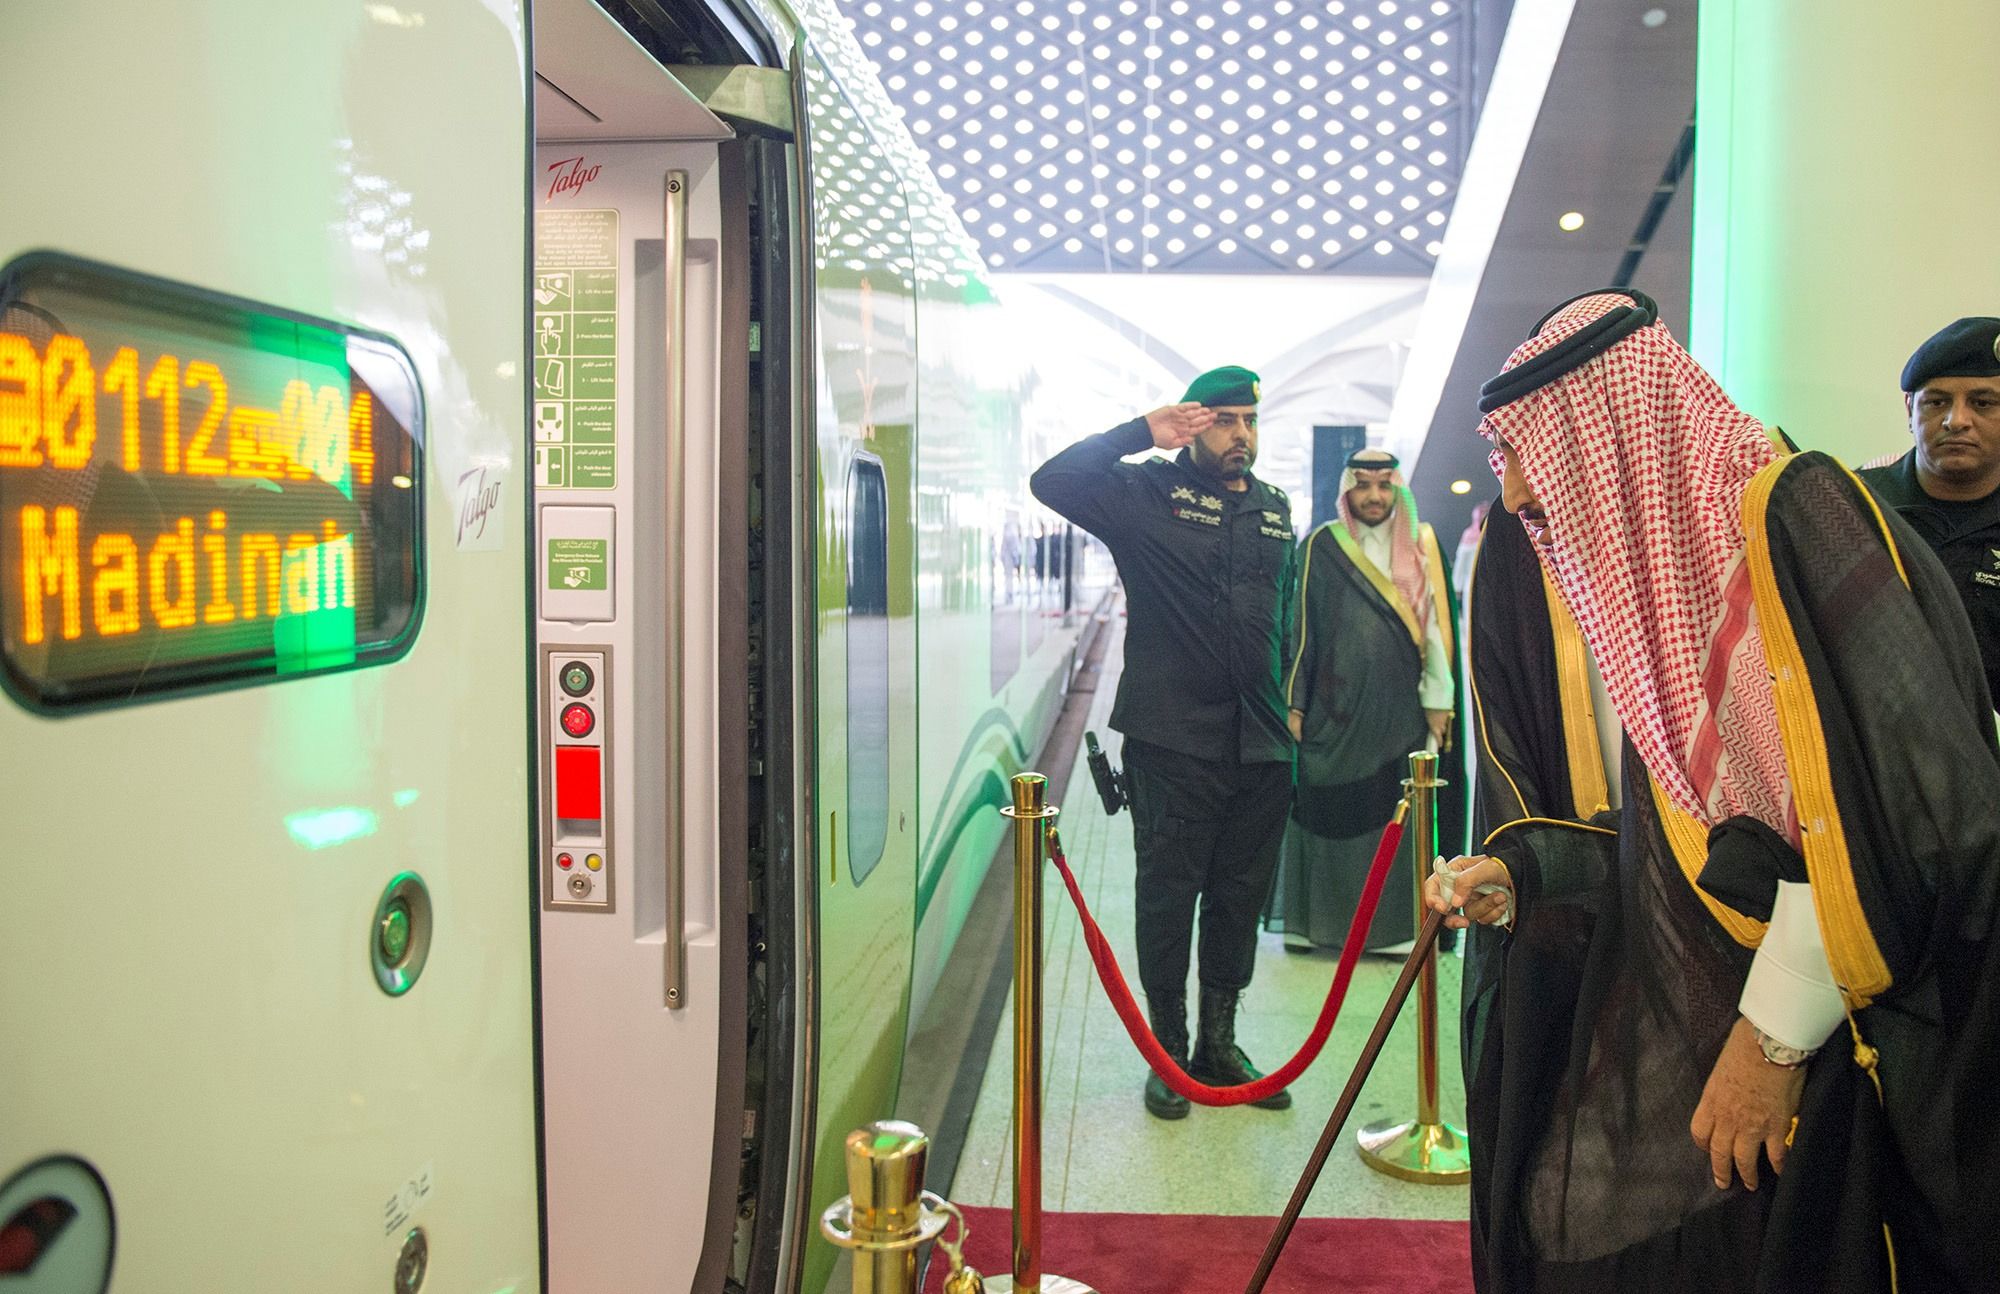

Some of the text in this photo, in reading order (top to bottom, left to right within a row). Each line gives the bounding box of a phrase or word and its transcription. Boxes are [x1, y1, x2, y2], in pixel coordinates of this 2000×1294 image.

[546, 156, 603, 203] Talgo
[457, 465, 501, 547] Talgo
[22, 505, 354, 644] Madinah
